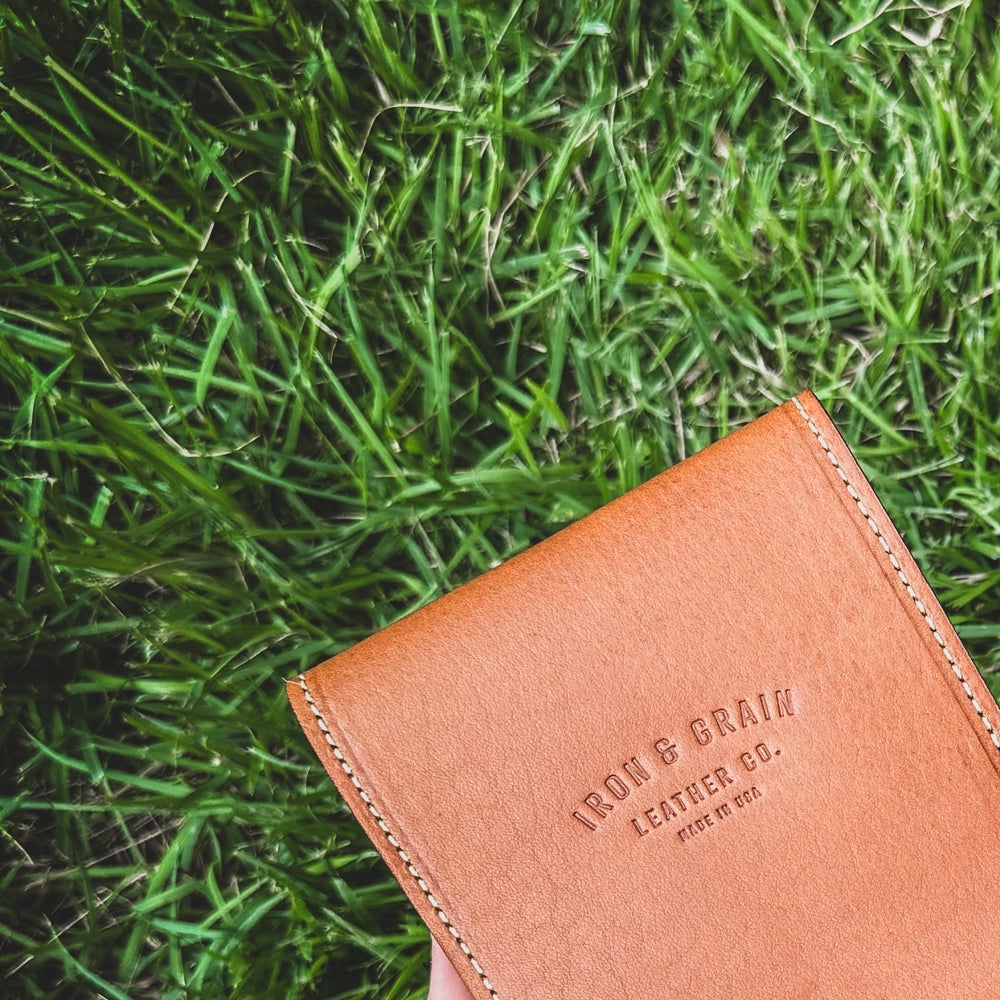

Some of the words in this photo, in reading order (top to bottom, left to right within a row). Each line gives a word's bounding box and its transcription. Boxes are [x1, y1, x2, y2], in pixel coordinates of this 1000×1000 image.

[572, 757, 651, 831] IRON
[655, 738, 679, 765] &
[690, 689, 796, 746] GRAIN
[631, 767, 734, 837] LEATHER
[740, 742, 782, 772] CO.
[677, 814, 716, 843] MADE
[715, 803, 733, 819] IN
[734, 786, 763, 808] USA
